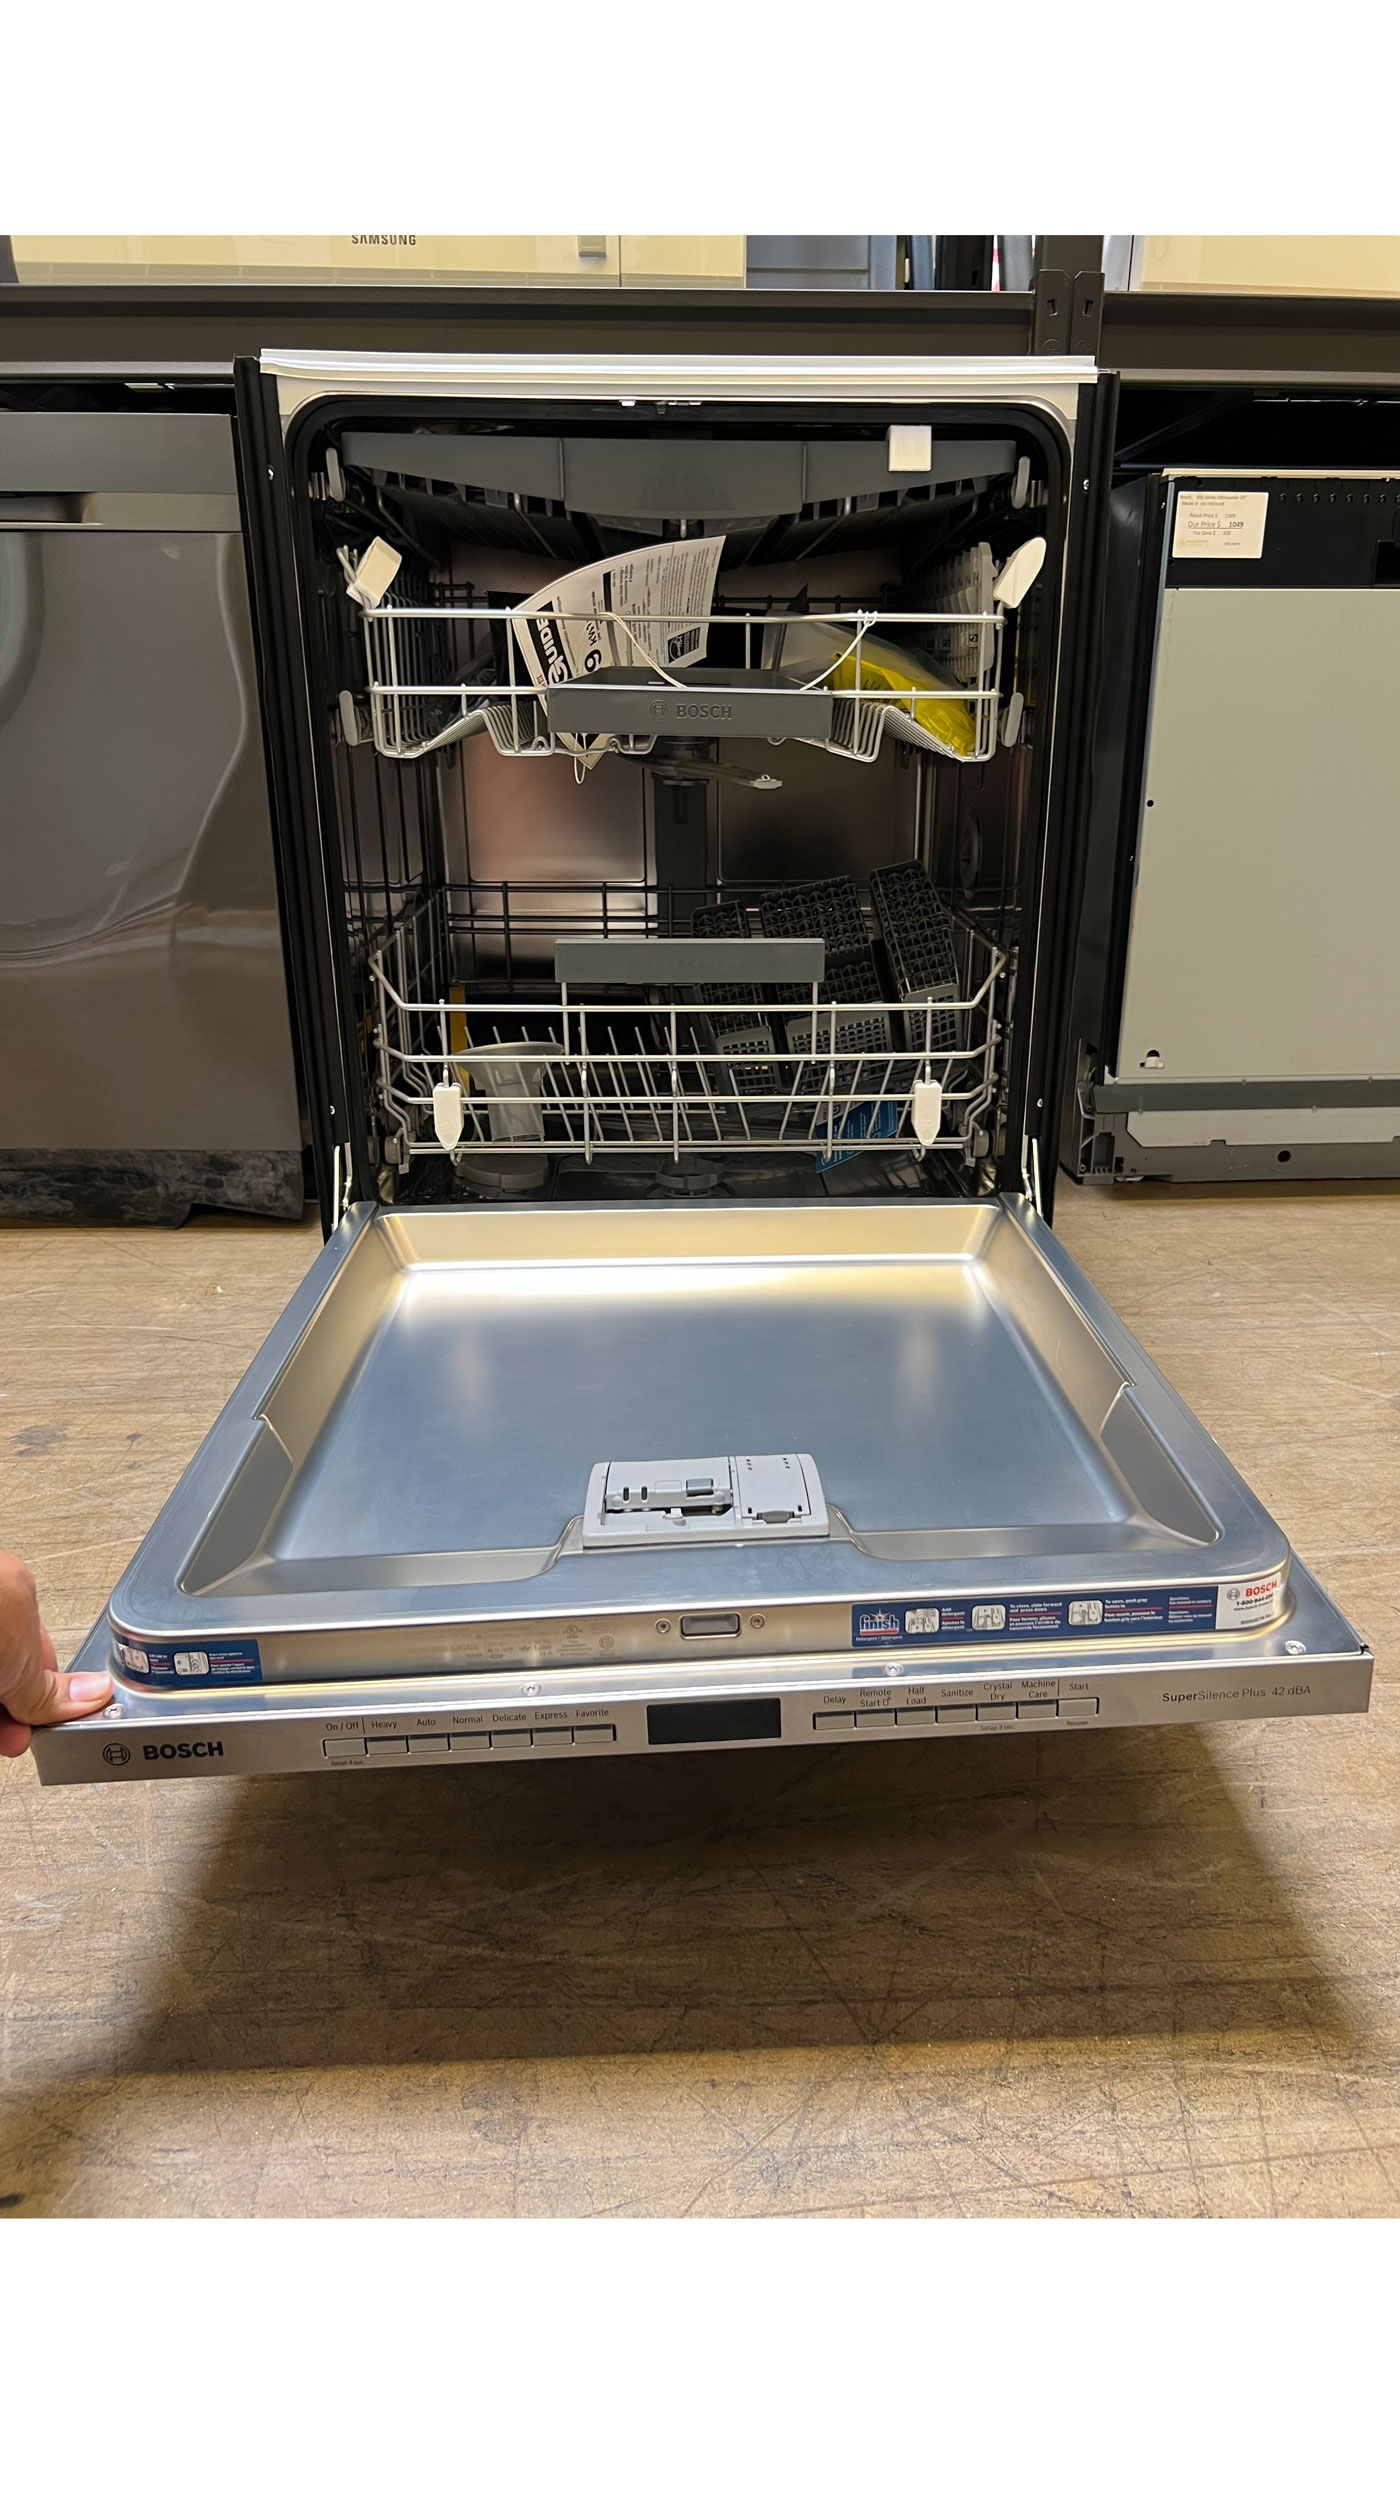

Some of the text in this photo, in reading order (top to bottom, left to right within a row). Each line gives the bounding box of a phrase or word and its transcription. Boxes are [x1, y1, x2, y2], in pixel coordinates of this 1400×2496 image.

[351, 234, 417, 246] SAMSUNG
[676, 704, 732, 719] BOSCH
[1245, 1579, 1277, 1597] BOSCH
[860, 1614, 899, 1630] finish
[983, 1681, 1013, 1692] Crystal
[1021, 1680, 1056, 1689] Machine
[1068, 1682, 1089, 1691] Start
[860, 1688, 892, 1697] Remote
[908, 1686, 925, 1695] Half
[940, 1688, 974, 1697] Sanitize
[1028, 1690, 1048, 1698] Care
[1162, 1685, 1311, 1703] SuperSilence Plus 42 dBA
[823, 1696, 846, 1704] Delay
[906, 1697, 927, 1705] Load
[990, 1692, 1005, 1701] Dry
[860, 1699, 880, 1707] Start
[492, 1713, 526, 1722] Delicate
[534, 1711, 568, 1720] Express
[576, 1708, 609, 1718] Favorite
[416, 1718, 436, 1727] Auto
[452, 1715, 483, 1724] Normal
[326, 1723, 339, 1731] On
[346, 1721, 359, 1730] Off
[371, 1720, 397, 1729] Heavy
[142, 1741, 224, 1760] BOSCH
